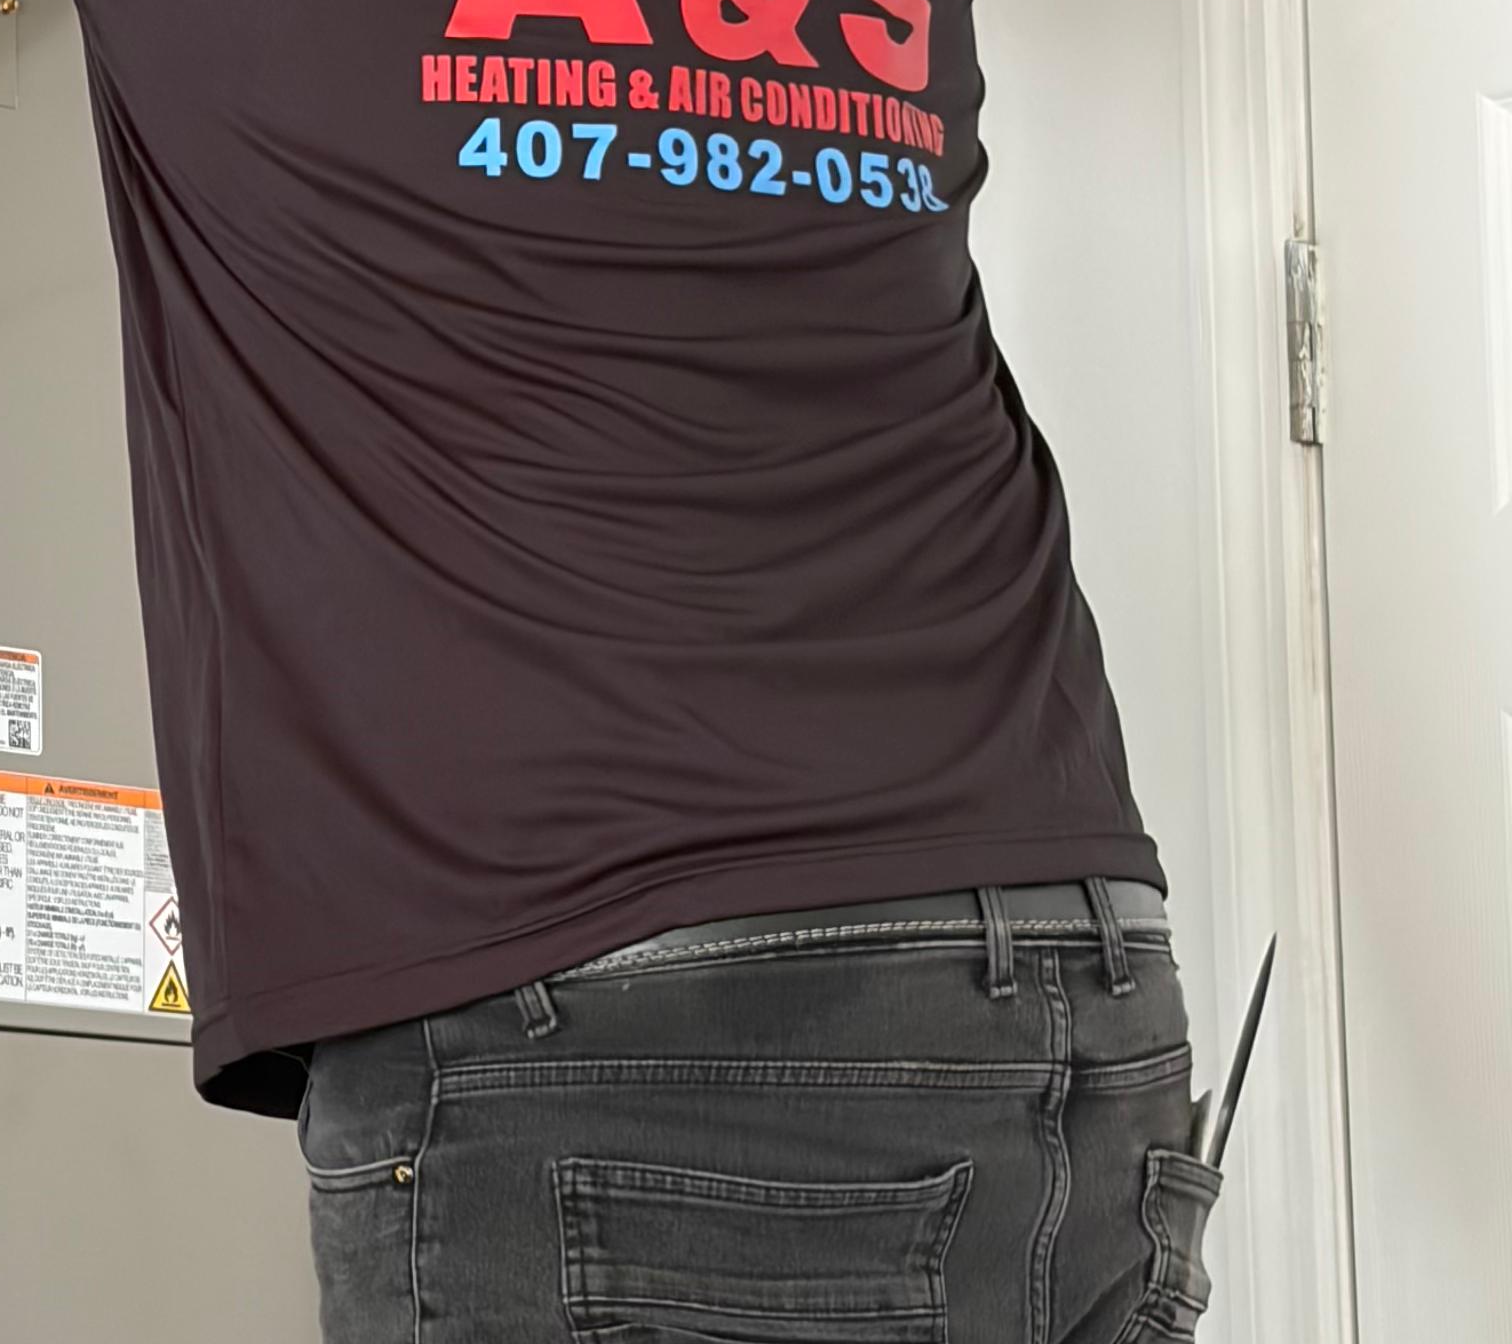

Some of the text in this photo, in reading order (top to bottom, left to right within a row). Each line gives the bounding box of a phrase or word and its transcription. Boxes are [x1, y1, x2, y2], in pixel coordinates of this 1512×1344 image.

[422, 54, 945, 156] HEATING & AIR CONDITIONING
